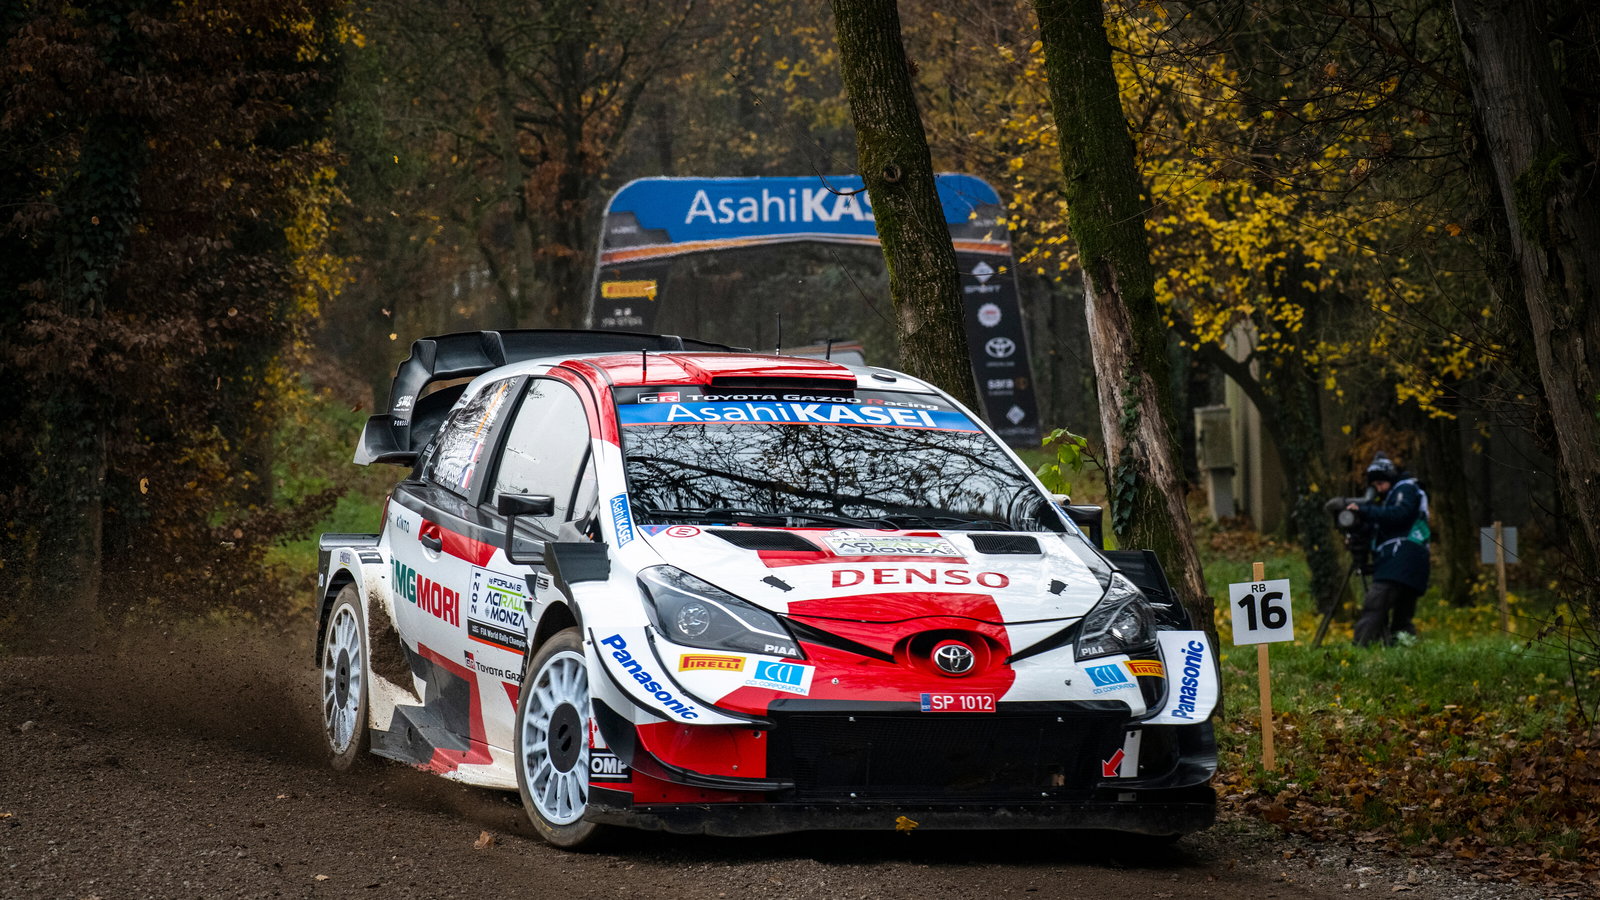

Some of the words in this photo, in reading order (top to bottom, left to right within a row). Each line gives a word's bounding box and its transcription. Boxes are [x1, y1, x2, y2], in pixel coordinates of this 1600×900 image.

[639, 392, 679, 403] GR
[783, 394, 861, 404] GAZOO
[867, 398, 938, 411] Racing
[667, 403, 937, 427] AsahiKASEI
[861, 547, 948, 555] MONZA
[832, 568, 1009, 588] DENSO
[471, 572, 481, 614] 2021
[1251, 584, 1266, 593] RB
[490, 608, 525, 629] MONZA
[1238, 592, 1287, 631] 16
[487, 629, 498, 640] World
[764, 644, 797, 656] PIAA
[1081, 646, 1105, 656] PIAA
[476, 662, 503, 678] TOYOTA
[683, 656, 742, 669] PIRELLI
[601, 634, 699, 720] Panasonic
[1171, 640, 1204, 720] Panasonic
[759, 681, 807, 693] CORPORATION
[1104, 683, 1137, 693] CORPORATION
[932, 695, 954, 710] SP
[959, 695, 992, 710] 1012
